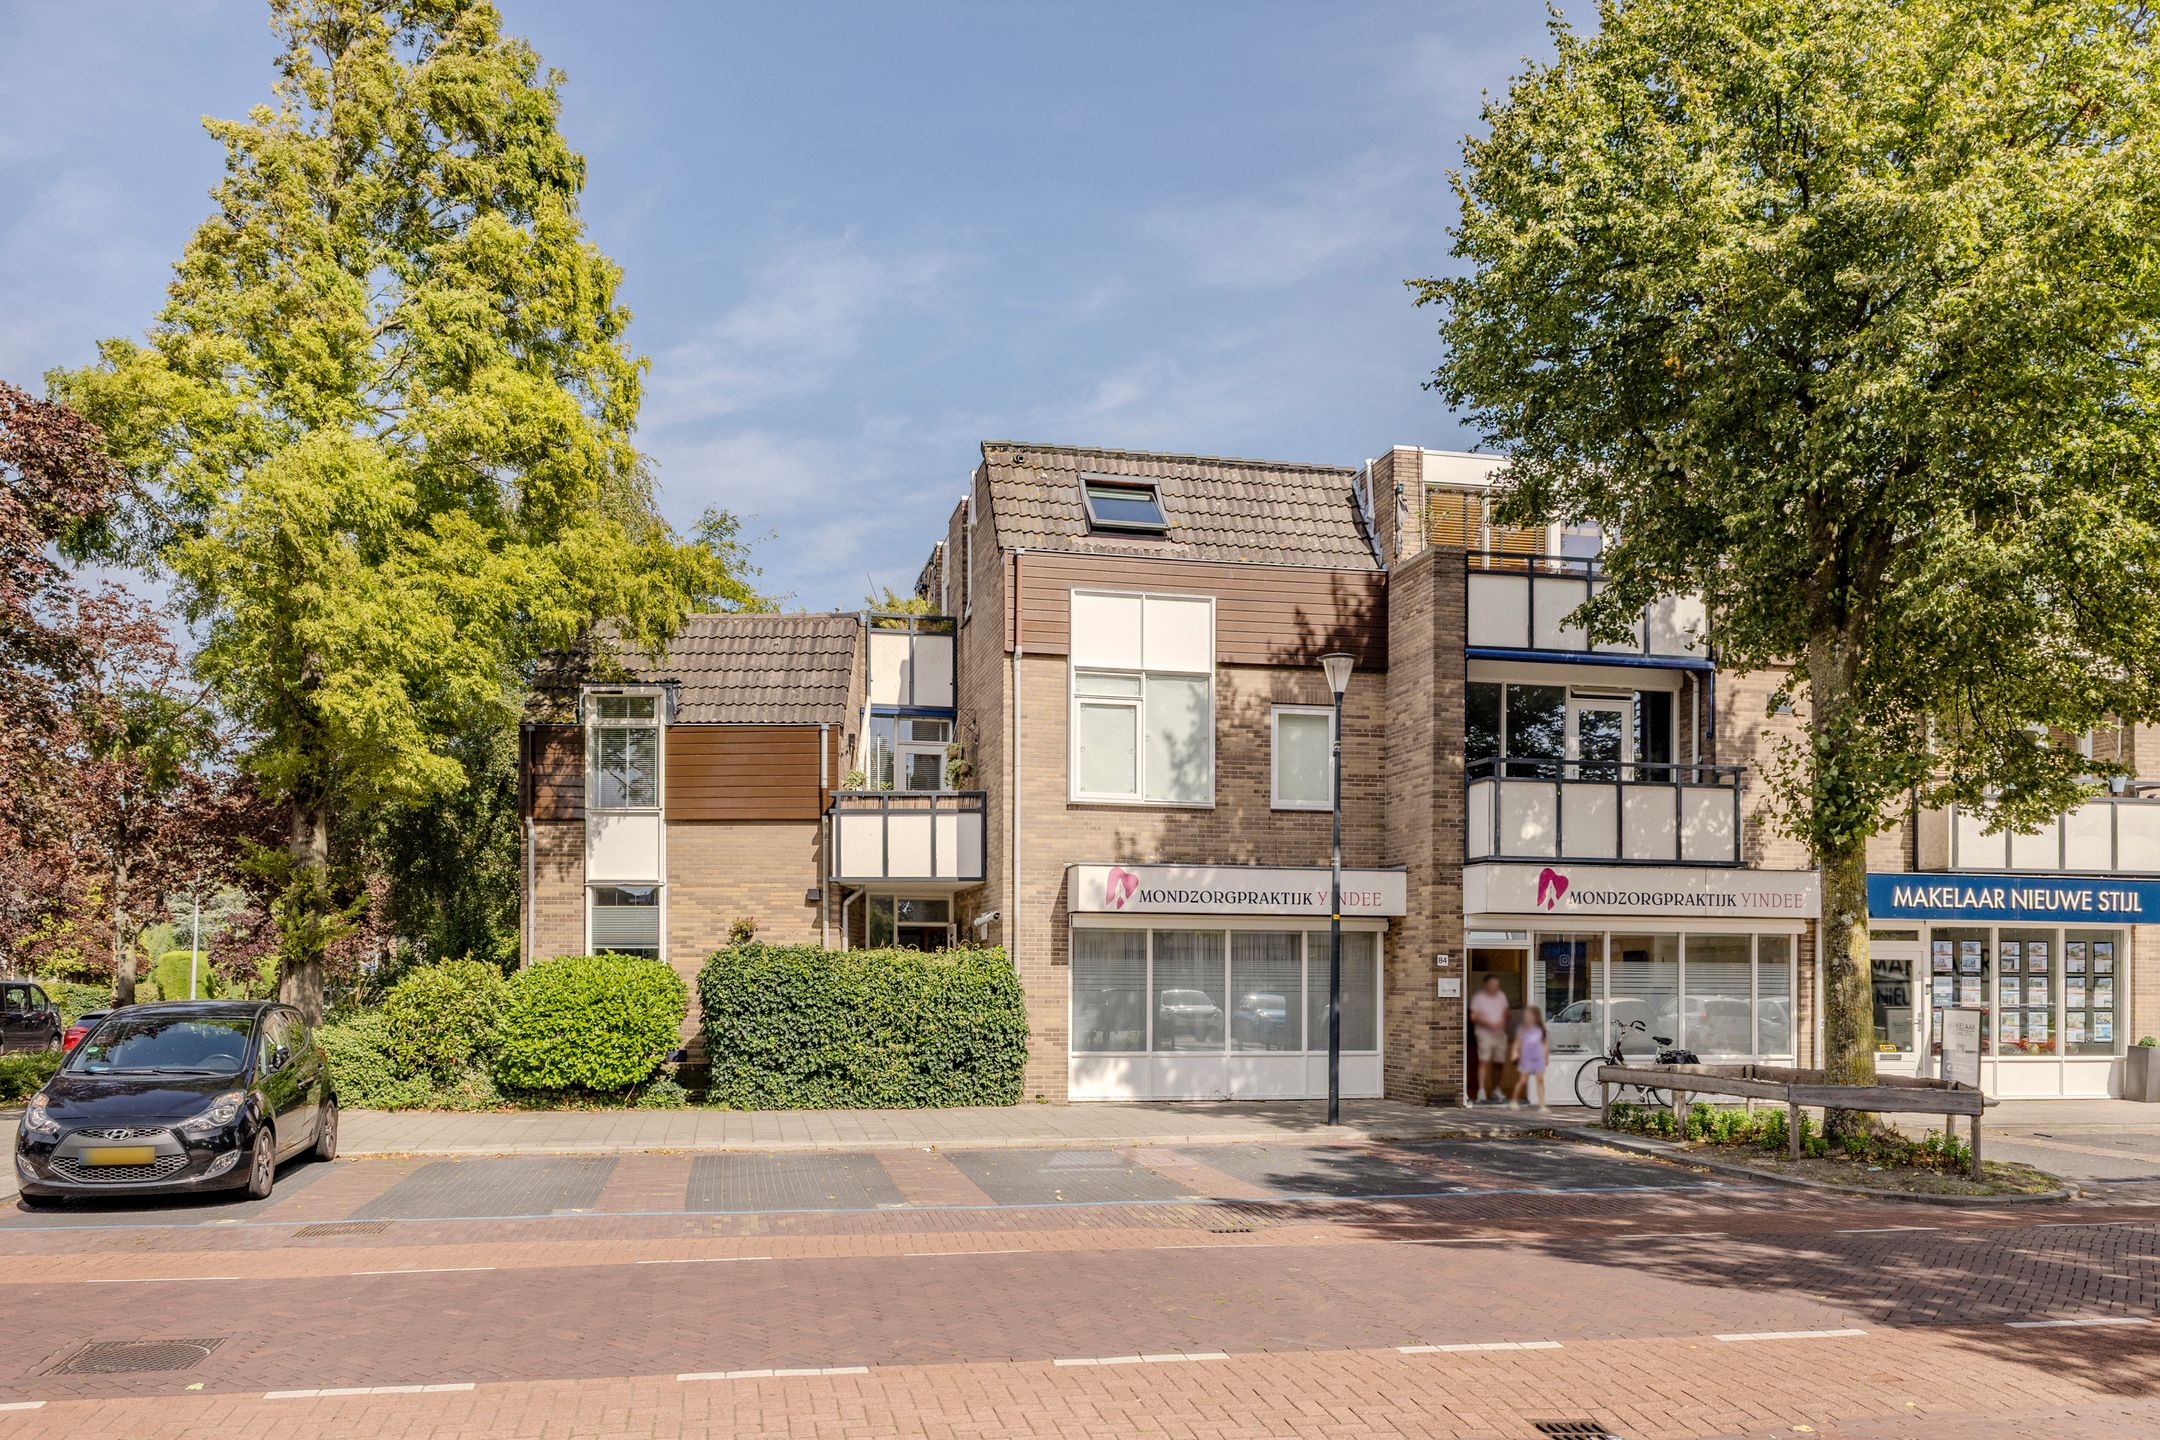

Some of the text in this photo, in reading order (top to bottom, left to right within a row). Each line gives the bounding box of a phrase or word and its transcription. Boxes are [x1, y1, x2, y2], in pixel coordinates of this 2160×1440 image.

[1138, 889, 1313, 906] MONDZORGPRAKTIJK
[1569, 891, 1804, 909] MONDZORGPRAKTIJK YINDEE
[1892, 885, 2143, 913] MAKELAAR NIEUWE STIJL
[1438, 956, 1447, 964] 84
